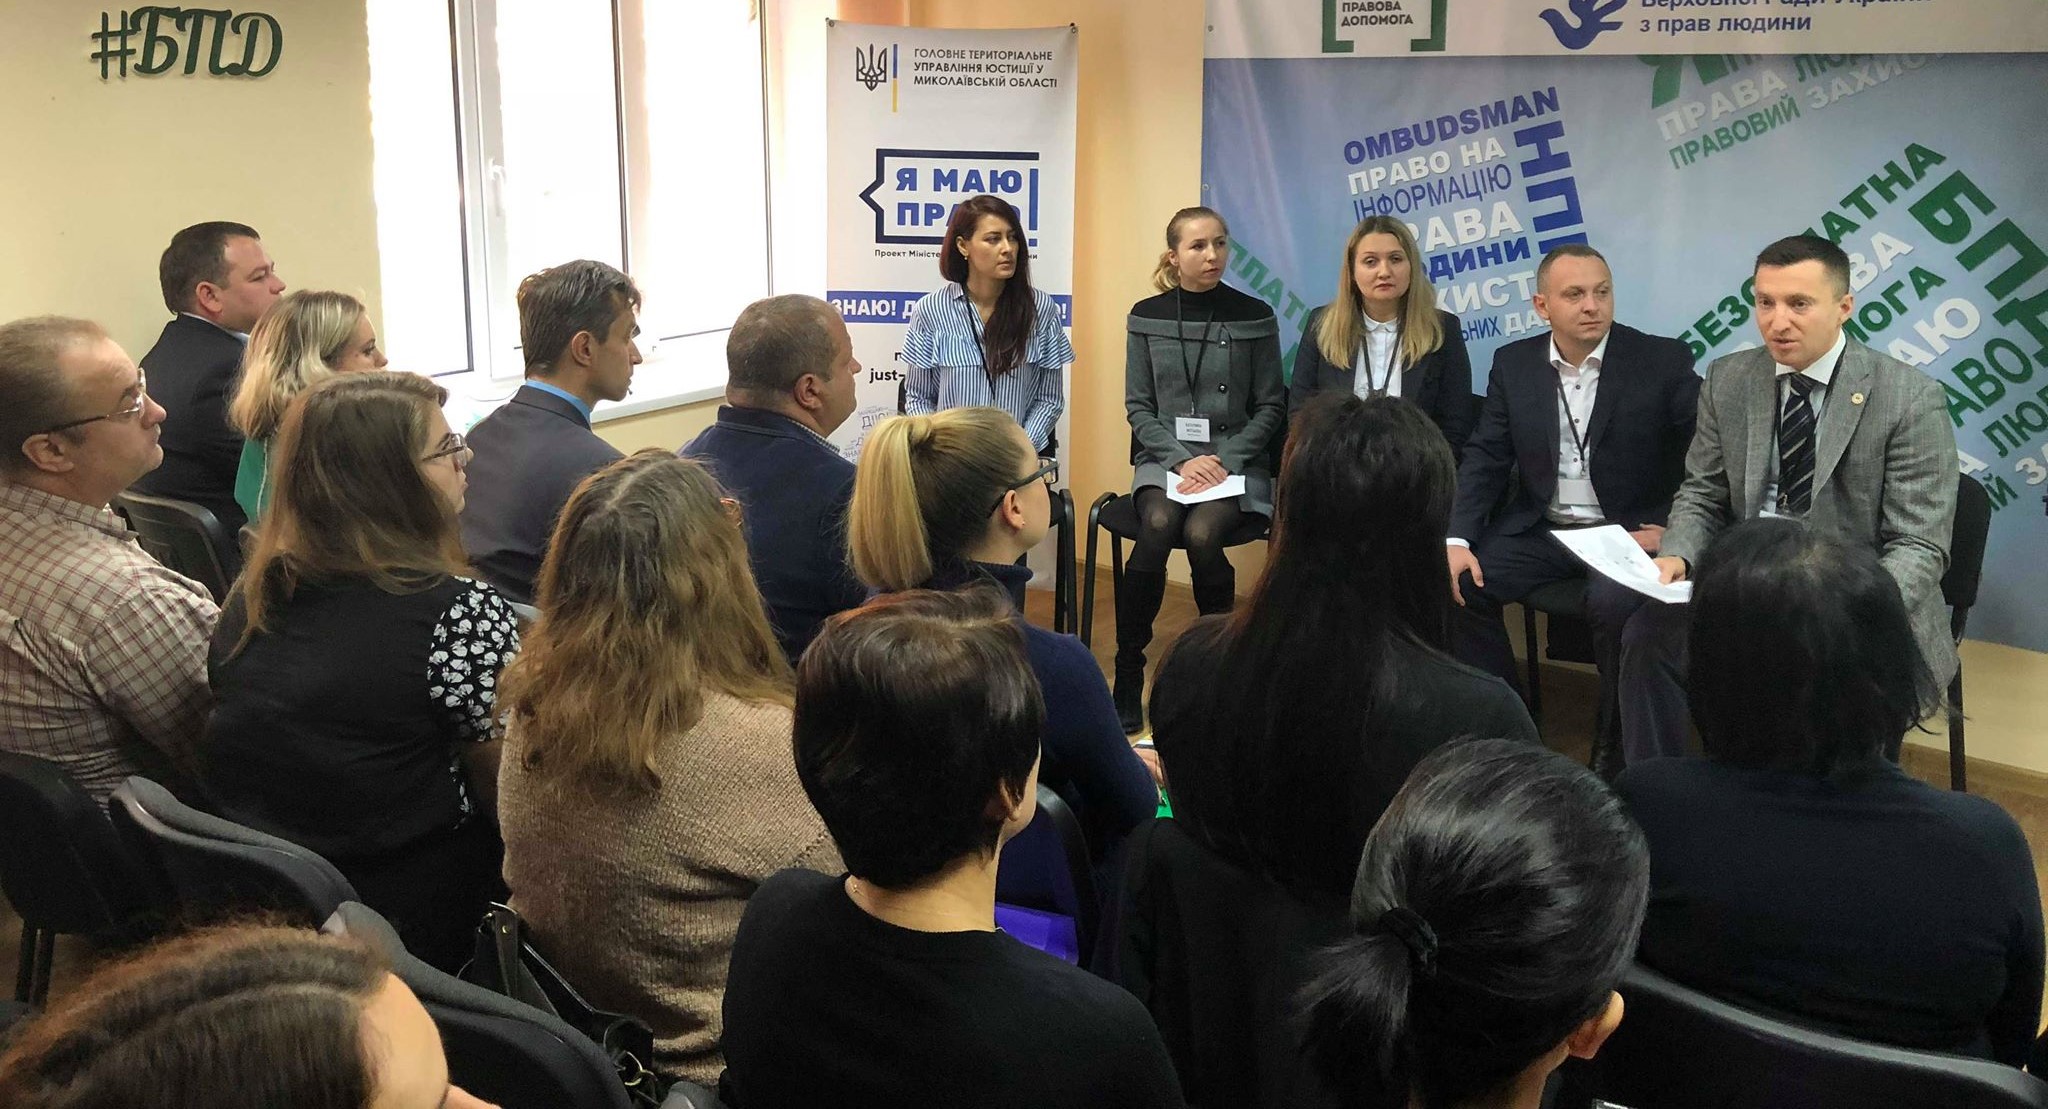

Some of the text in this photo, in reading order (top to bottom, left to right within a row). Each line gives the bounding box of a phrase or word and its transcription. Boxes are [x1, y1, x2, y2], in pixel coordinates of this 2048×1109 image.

[1342, 0, 1402, 13] ПРАВОВА
[1341, 14, 1414, 27] ДОПОМОГА
[1639, 17, 1812, 37] з прав людини
[914, 48, 1053, 61] ГОЛОВНЕ ТЕРИТОРІАЛЬНЕ
[913, 62, 1044, 75] УПРАВЛІННЯ ЮСТИЦІЇ У
[913, 75, 1058, 88] МИКОЛАЇВСЬКІЙ ОБЛАСТІ
[1656, 68, 1788, 142] ПРАВА
[1343, 86, 1561, 166] OMBUDSMAN
[1669, 92, 1801, 170] ПРАВОВИЙ
[1347, 137, 1507, 195] ПРАВО НА
[895, 168, 1023, 194] Я МАЮ
[1352, 163, 1512, 222] ІНФОРМАЦІЮ
[874, 249, 907, 260] Проект
